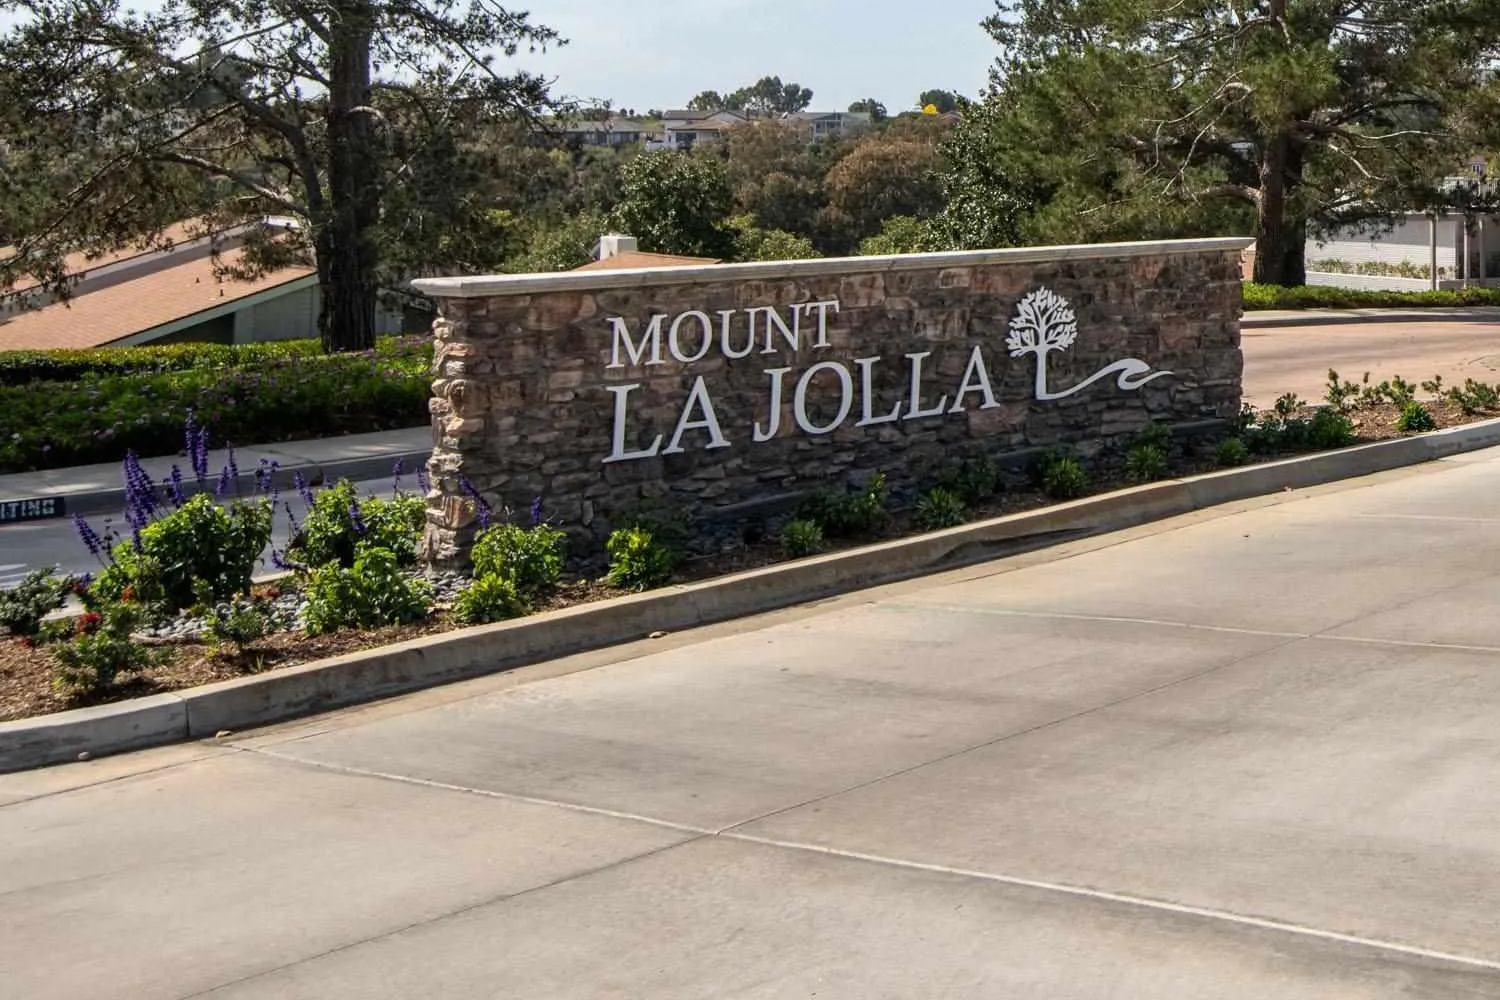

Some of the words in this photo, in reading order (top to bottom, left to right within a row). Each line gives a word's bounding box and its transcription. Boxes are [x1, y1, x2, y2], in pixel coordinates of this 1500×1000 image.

[604, 299, 840, 369] MOUNT
[602, 375, 732, 464] LA
[752, 344, 1000, 443] JOLLA
